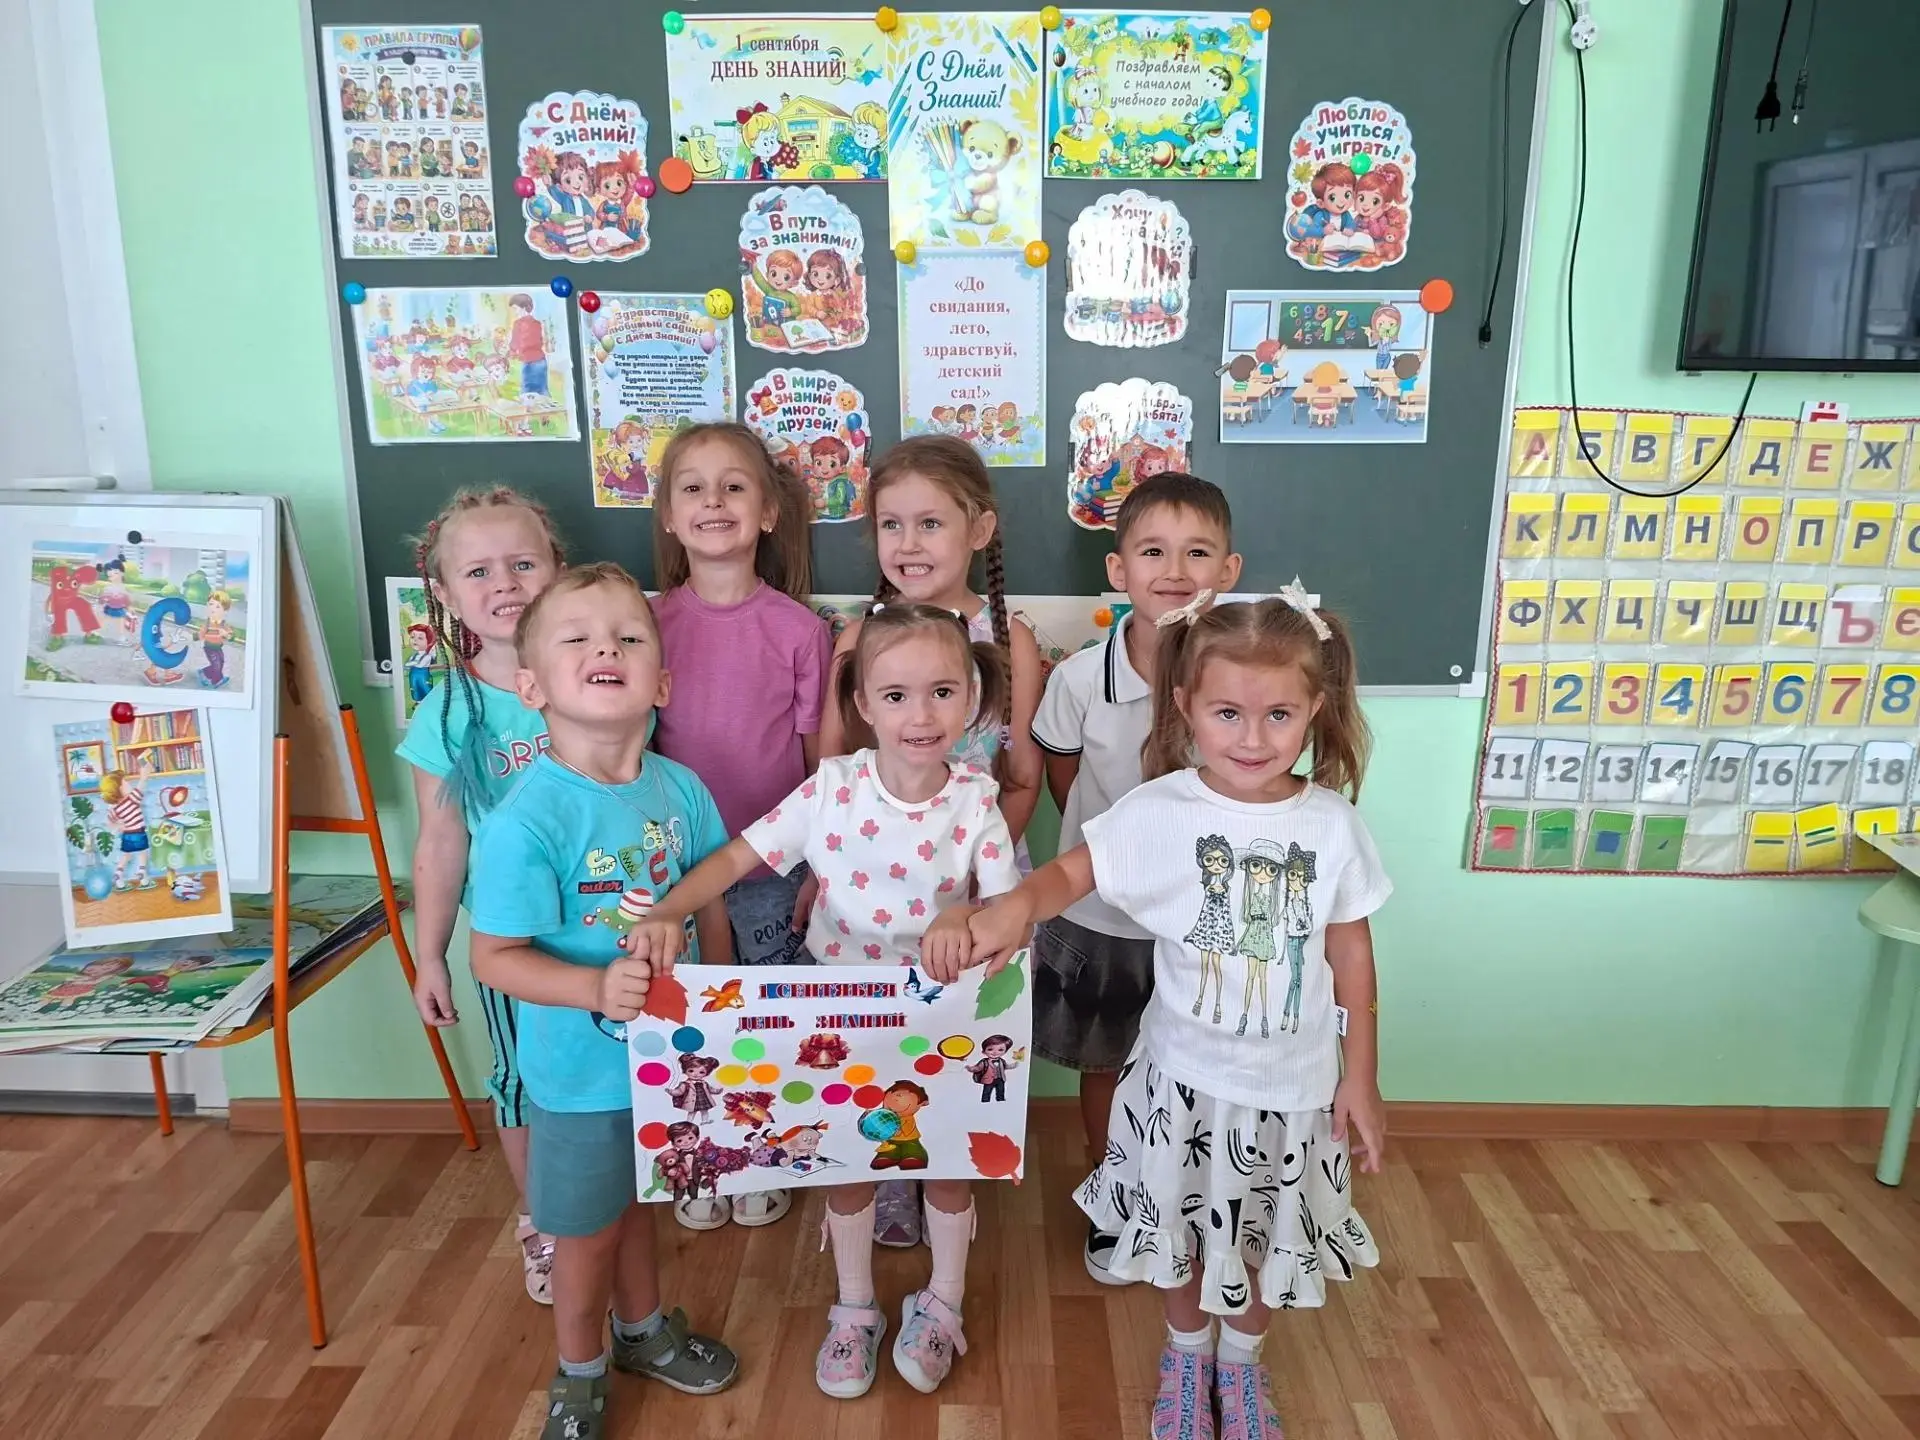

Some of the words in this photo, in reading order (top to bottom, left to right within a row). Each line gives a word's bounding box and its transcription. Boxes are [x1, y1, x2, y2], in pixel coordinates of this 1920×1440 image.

[364, 32, 414, 47] ПРАВИЛА
[417, 32, 458, 46] ГРУППЫ
[735, 35, 743, 51] 1
[749, 36, 819, 54] сентября
[711, 60, 759, 82] ДЕНЬ
[765, 58, 847, 79] ЗНАНИЙ!
[916, 50, 935, 79] С
[940, 51, 1004, 79] Днём
[1116, 60, 1201, 76] Поздравляем
[1124, 81, 1130, 90] с
[1135, 79, 1191, 90] началом
[919, 82, 1007, 111] Знаний!
[1110, 94, 1166, 109] учебного
[1171, 94, 1203, 107] года!
[547, 102, 564, 124] С
[569, 102, 627, 123] Днём
[1316, 104, 1387, 127] Люблю
[554, 125, 636, 147] знаний!
[1316, 120, 1393, 142] учиться
[1314, 146, 1326, 160] и
[1331, 140, 1401, 160] играть!
[769, 213, 784, 232] В
[787, 216, 828, 231] путь
[750, 236, 768, 250] за
[771, 230, 857, 250] знаниями!
[954, 276, 985, 293] «До
[615, 309, 693, 322] Здравствуй,
[929, 300, 1011, 316] свидания,
[608, 320, 662, 335] любимый
[1321, 317, 1333, 342] 1
[1334, 310, 1349, 331] 7
[616, 336, 623, 344] с
[655, 332, 696, 346] Знаний!
[950, 324, 990, 337] лето,
[922, 341, 1018, 359] здравствуй,
[938, 364, 1002, 380] детский
[772, 374, 786, 391] В
[791, 376, 838, 393] мире
[775, 390, 832, 405] знаний
[950, 386, 991, 401] сад!»
[781, 404, 826, 418] много
[776, 416, 838, 433] друзей!
[1523, 433, 1549, 461] А
[1576, 432, 1602, 461] Б
[1631, 434, 1657, 463] В
[1693, 437, 1715, 466] Г
[1748, 442, 1781, 476] Д
[1859, 441, 1898, 469] Ж
[1516, 514, 1541, 541] К
[1567, 514, 1597, 541] Л
[1624, 514, 1658, 543] М
[1684, 517, 1711, 544] Н
[1743, 516, 1770, 545] О
[1797, 518, 1824, 547] П
[1853, 522, 1880, 549] Р
[1508, 598, 1541, 627] Ф
[1559, 598, 1588, 625] Х
[1616, 598, 1643, 630] Ц
[1677, 599, 1701, 626] Ч
[1725, 599, 1758, 625] Ш
[1777, 600, 1818, 633] Щ
[1832, 602, 1874, 644] Ъ
[1508, 674, 1528, 713] 1
[1552, 674, 1583, 714] 2
[1608, 675, 1642, 715] 3
[1660, 677, 1693, 715] 4
[1721, 677, 1753, 715] 5
[1772, 675, 1806, 714] 6
[1831, 677, 1862, 715] 7
[1881, 674, 1916, 714] 8
[1491, 753, 1526, 780] 11
[1544, 756, 1581, 783] 12
[1597, 757, 1633, 783] 13
[1647, 758, 1689, 785] 14
[1704, 756, 1742, 784] 15
[1756, 759, 1794, 786] 16
[1807, 760, 1848, 786] 17
[1865, 757, 1905, 786] 18
[759, 984, 768, 999] 1
[776, 983, 897, 998] СЕНТЯБРЯ
[735, 1016, 795, 1034] ДЕНЬ
[816, 1013, 907, 1029] ЗНАНИЙ
